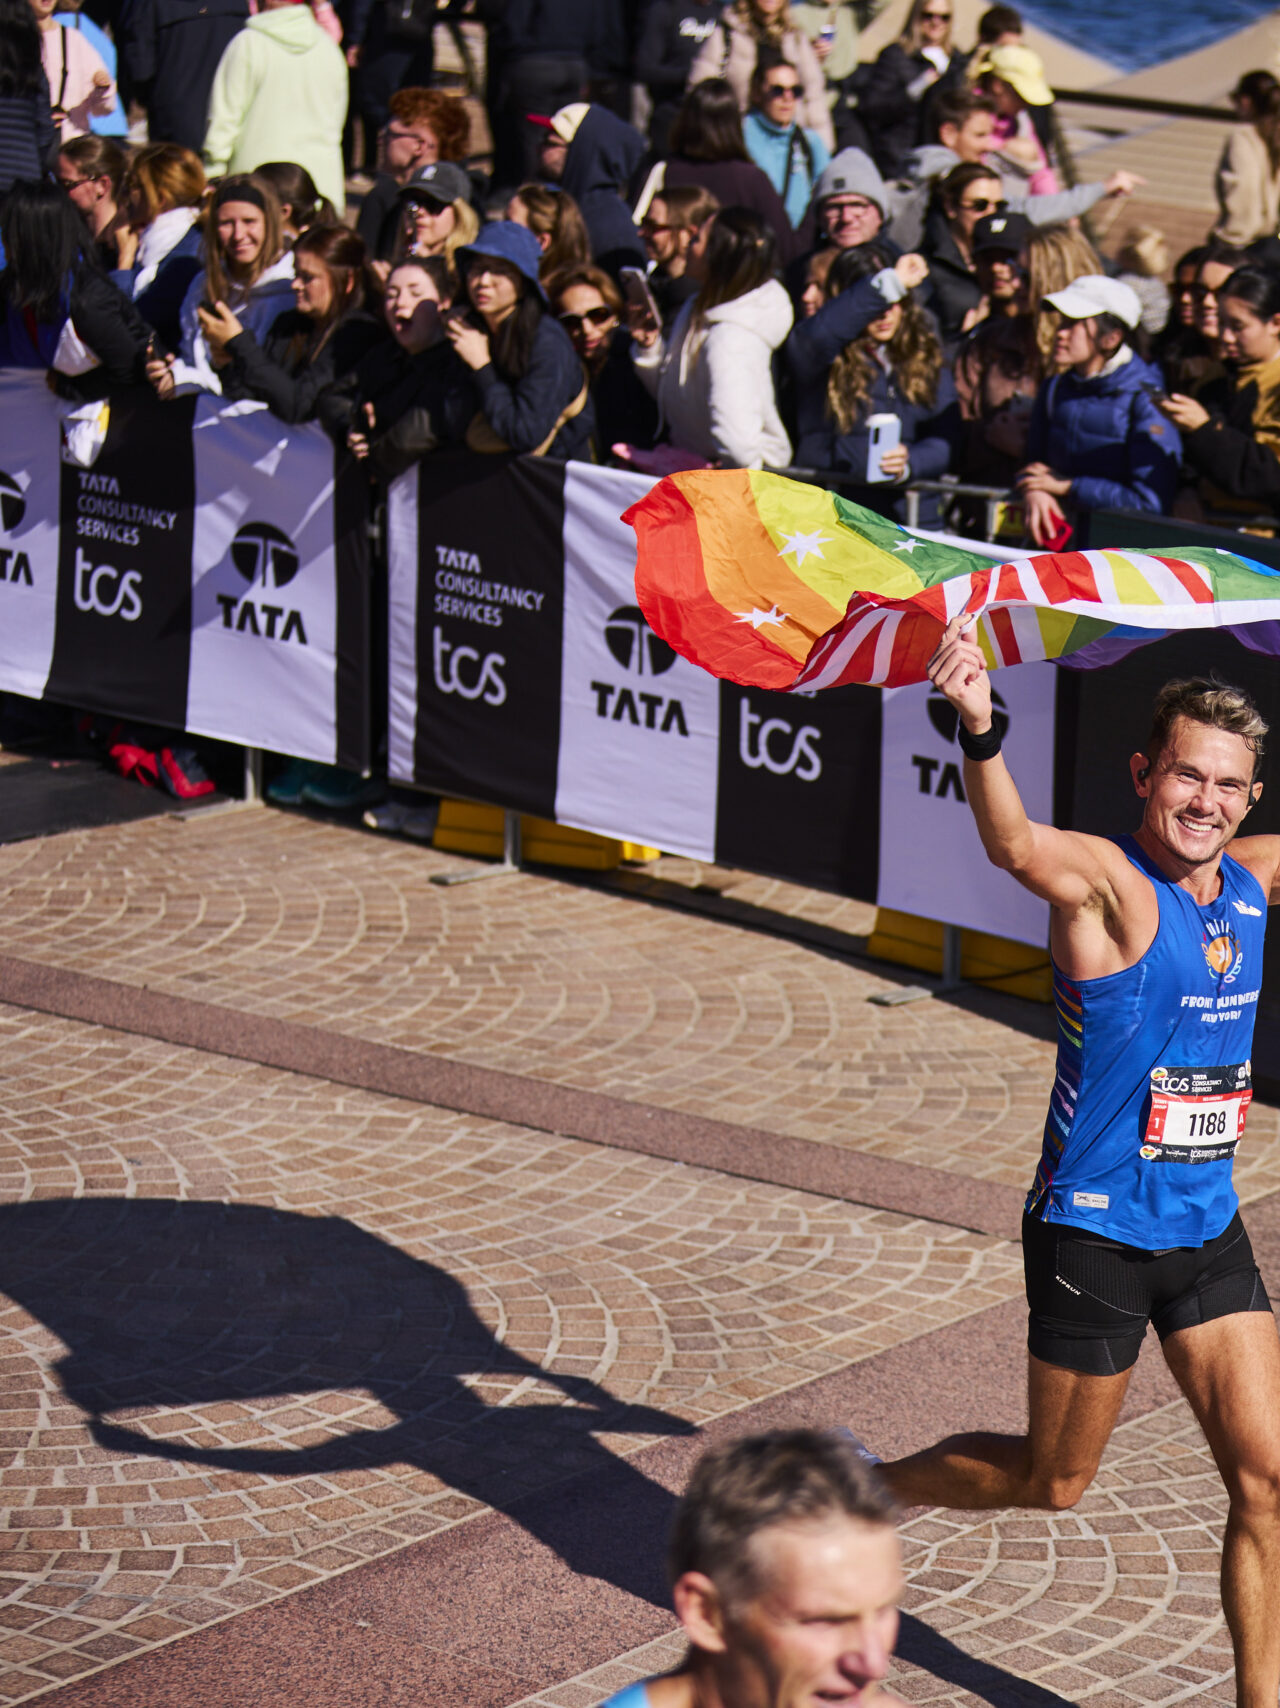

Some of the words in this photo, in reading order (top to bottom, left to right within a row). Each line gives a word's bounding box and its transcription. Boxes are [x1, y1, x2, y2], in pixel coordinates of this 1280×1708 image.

[78, 472, 120, 496] TATA
[78, 495, 177, 531] CONSULTANCY
[76, 517, 140, 546] SERVICES
[0, 547, 34, 586] TA
[435, 545, 481, 573] TATA
[74, 547, 142, 621] tcs
[435, 570, 544, 611] CONSULTANCY
[216, 594, 308, 645] TATA
[434, 594, 503, 627] SERVICES
[433, 624, 507, 706] tcs
[590, 681, 690, 738] TATA
[739, 697, 822, 782] tcs
[912, 754, 967, 804] TA
[1200, 1013, 1218, 1024] NEW
[1161, 1077, 1189, 1092] tcs
[1154, 1117, 1160, 1129] 1
[1188, 1110, 1227, 1137] 1188
[1238, 1113, 1244, 1125] A
